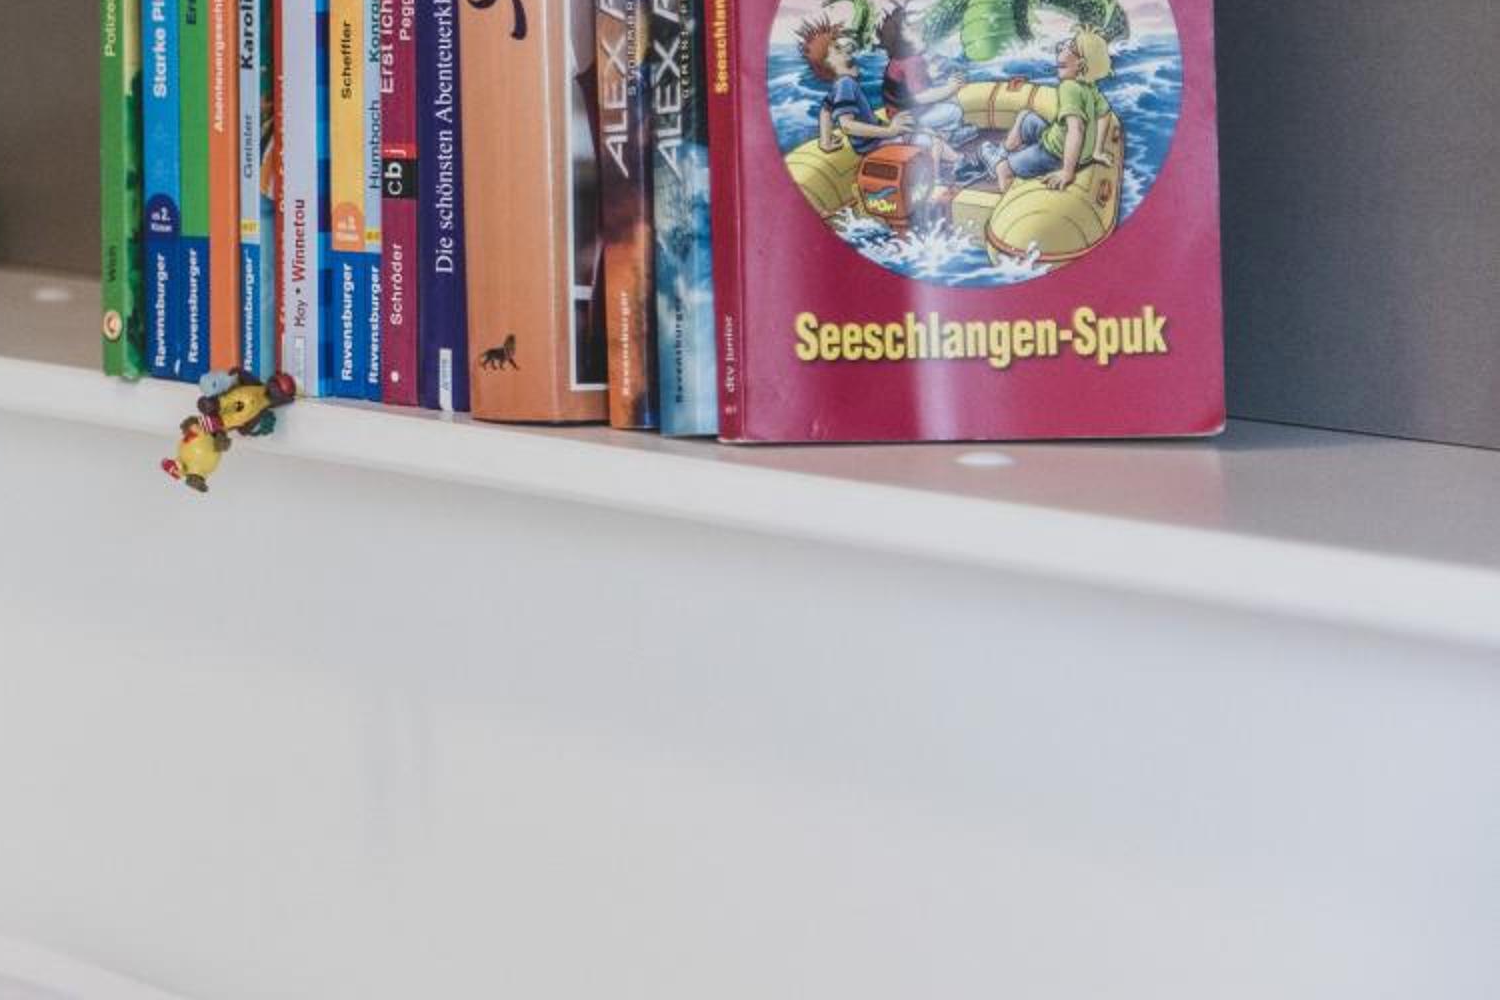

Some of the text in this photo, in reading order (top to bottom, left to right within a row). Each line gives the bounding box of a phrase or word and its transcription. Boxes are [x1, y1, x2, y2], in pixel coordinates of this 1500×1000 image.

[152, 28, 167, 97] Starke
[341, 21, 352, 100] Scheffler
[380, 0, 393, 35] ich
[381, 44, 394, 93] Erst
[600, 34, 629, 178] ALEX
[653, 38, 682, 183] ALEX
[369, 100, 380, 189] Humbach
[435, 130, 453, 230] schönsten
[292, 200, 305, 282] Winnetou
[390, 244, 403, 325] Schröder
[436, 237, 453, 273] Die
[155, 253, 168, 366] Ravensburger
[188, 248, 200, 362] Ravensburger
[244, 258, 253, 372] Ravensburger
[341, 264, 354, 381] Ravensburger
[369, 266, 381, 383] Ravensburger
[621, 291, 631, 396] Ravensburger
[796, 304, 1168, 369] Seeschlangen-Spuk
